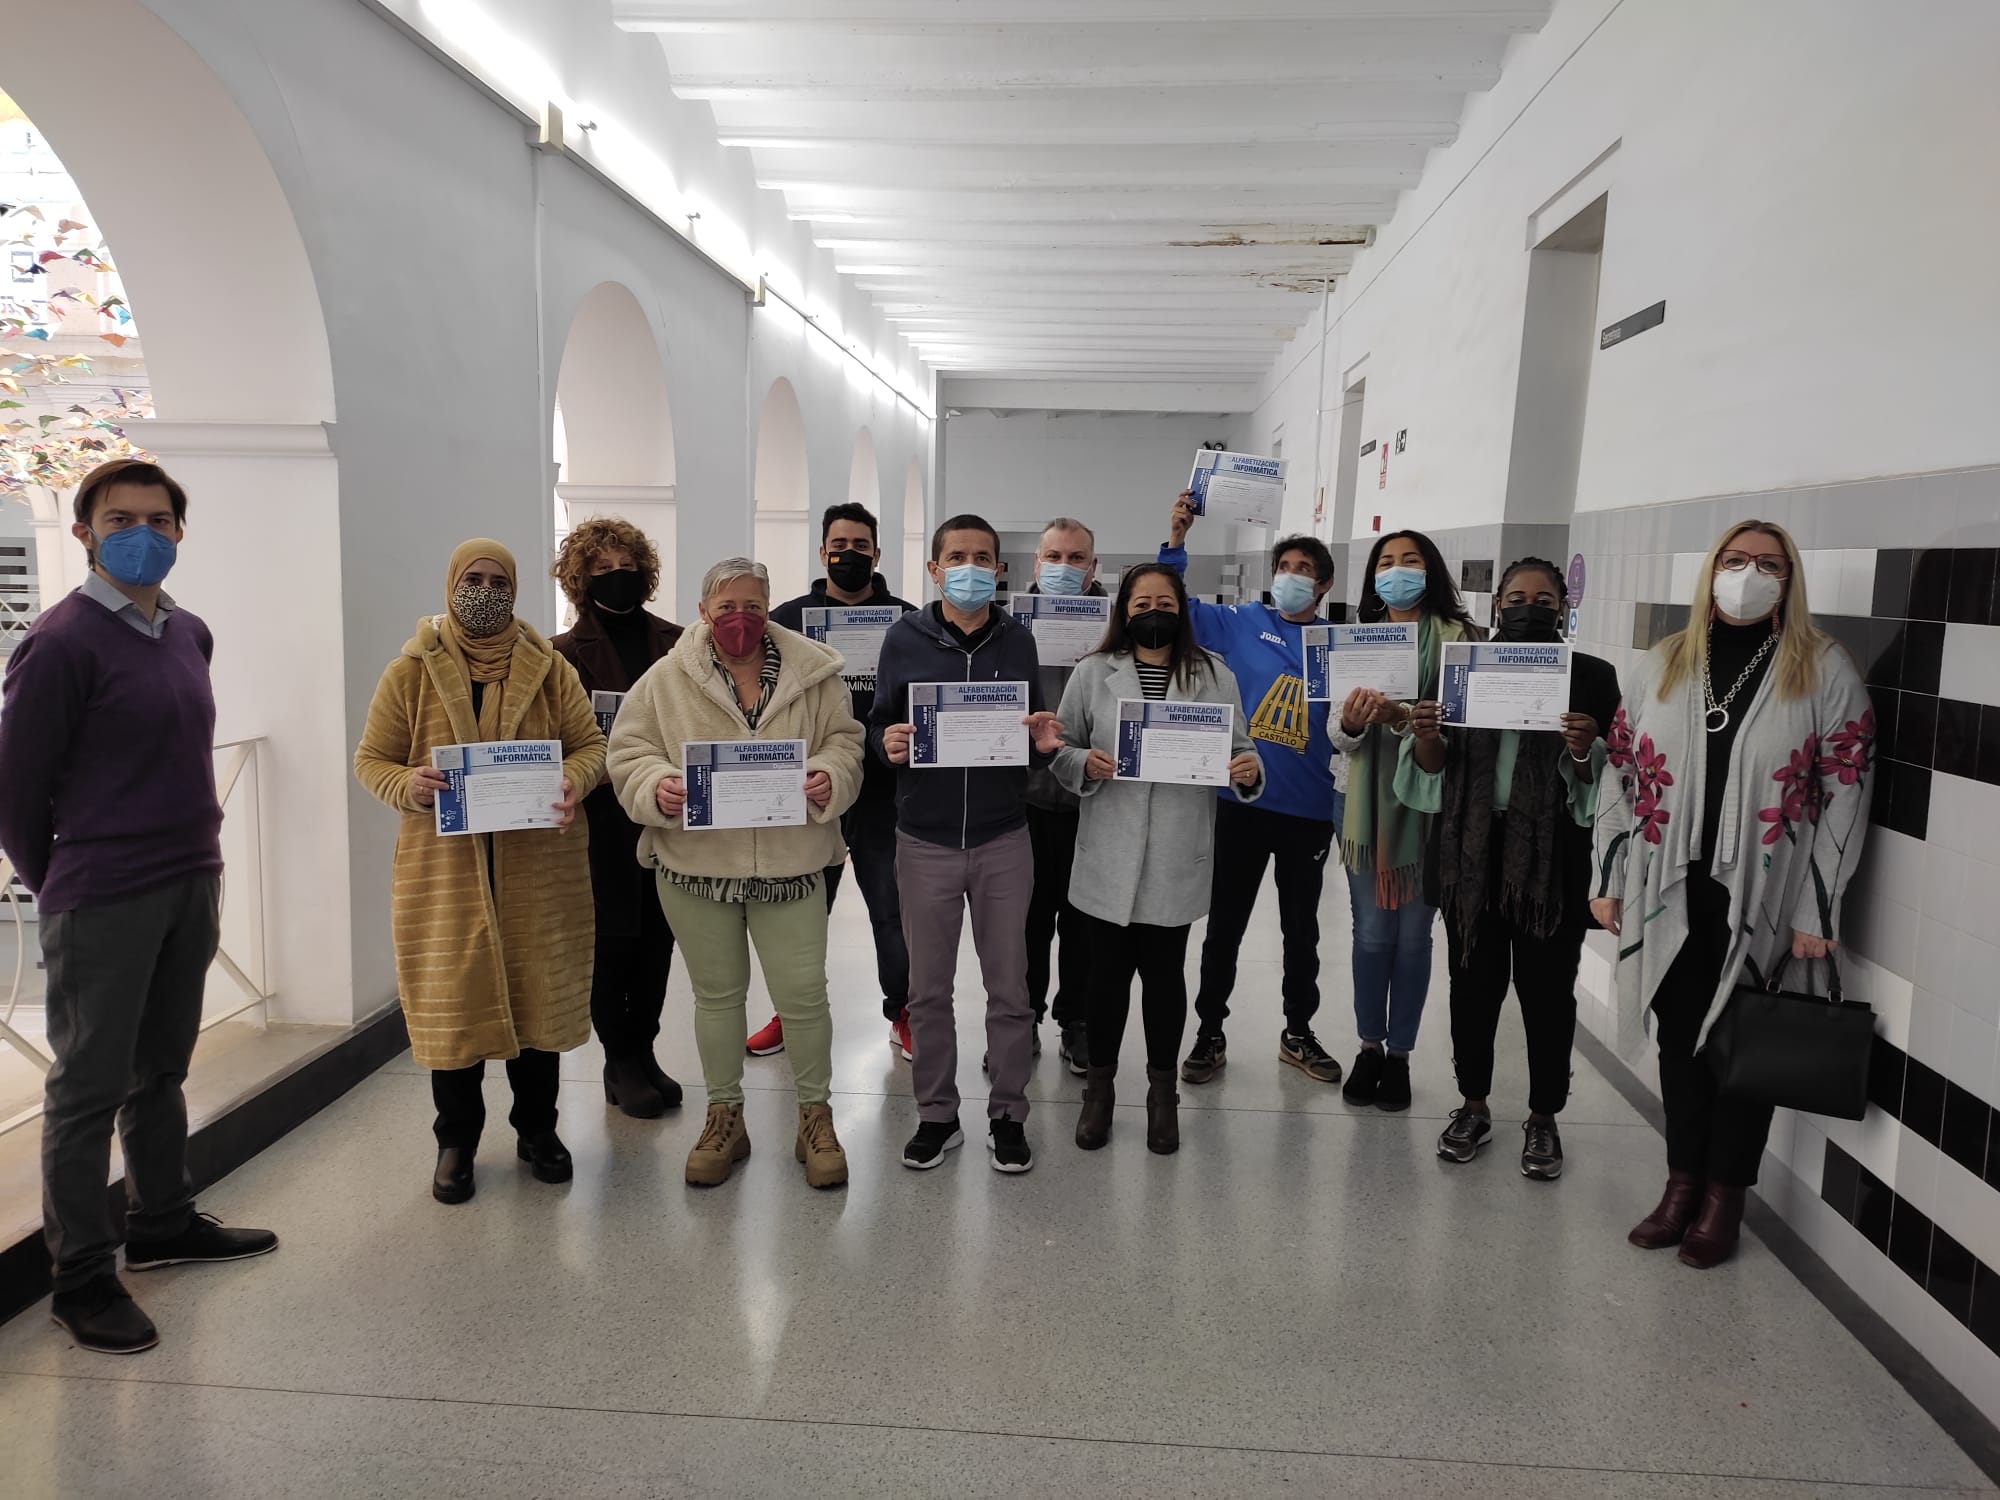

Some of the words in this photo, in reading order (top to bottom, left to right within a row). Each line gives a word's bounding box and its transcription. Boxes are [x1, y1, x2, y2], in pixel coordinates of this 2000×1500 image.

[1232, 457, 1280, 467] ALFABETIZACIÓN
[1234, 464, 1278, 476] INFORMÁTICA
[1349, 626, 1406, 634] ALFABETIZACIÓN
[1354, 634, 1407, 642] INFORMÁTICA
[1494, 647, 1559, 655] ALFABETIZACIÓN
[1499, 654, 1558, 664] INFORMÁTICA
[848, 681, 877, 691] MINA
[958, 685, 1017, 693] ALFABETIZACIÓN
[964, 693, 1017, 702] INFORMÁTICA
[1165, 706, 1223, 714] ALFABETIZACIÓN
[1169, 714, 1222, 723] INFORMÁTICA
[1259, 731, 1296, 746] CASTILLO
[487, 745, 551, 754] ALFABETIZACIÓN
[734, 743, 795, 752] ALFABETIZACIÓN
[494, 752, 551, 763] INFORMÁTICA
[739, 751, 795, 761] INFORMÁTICA
